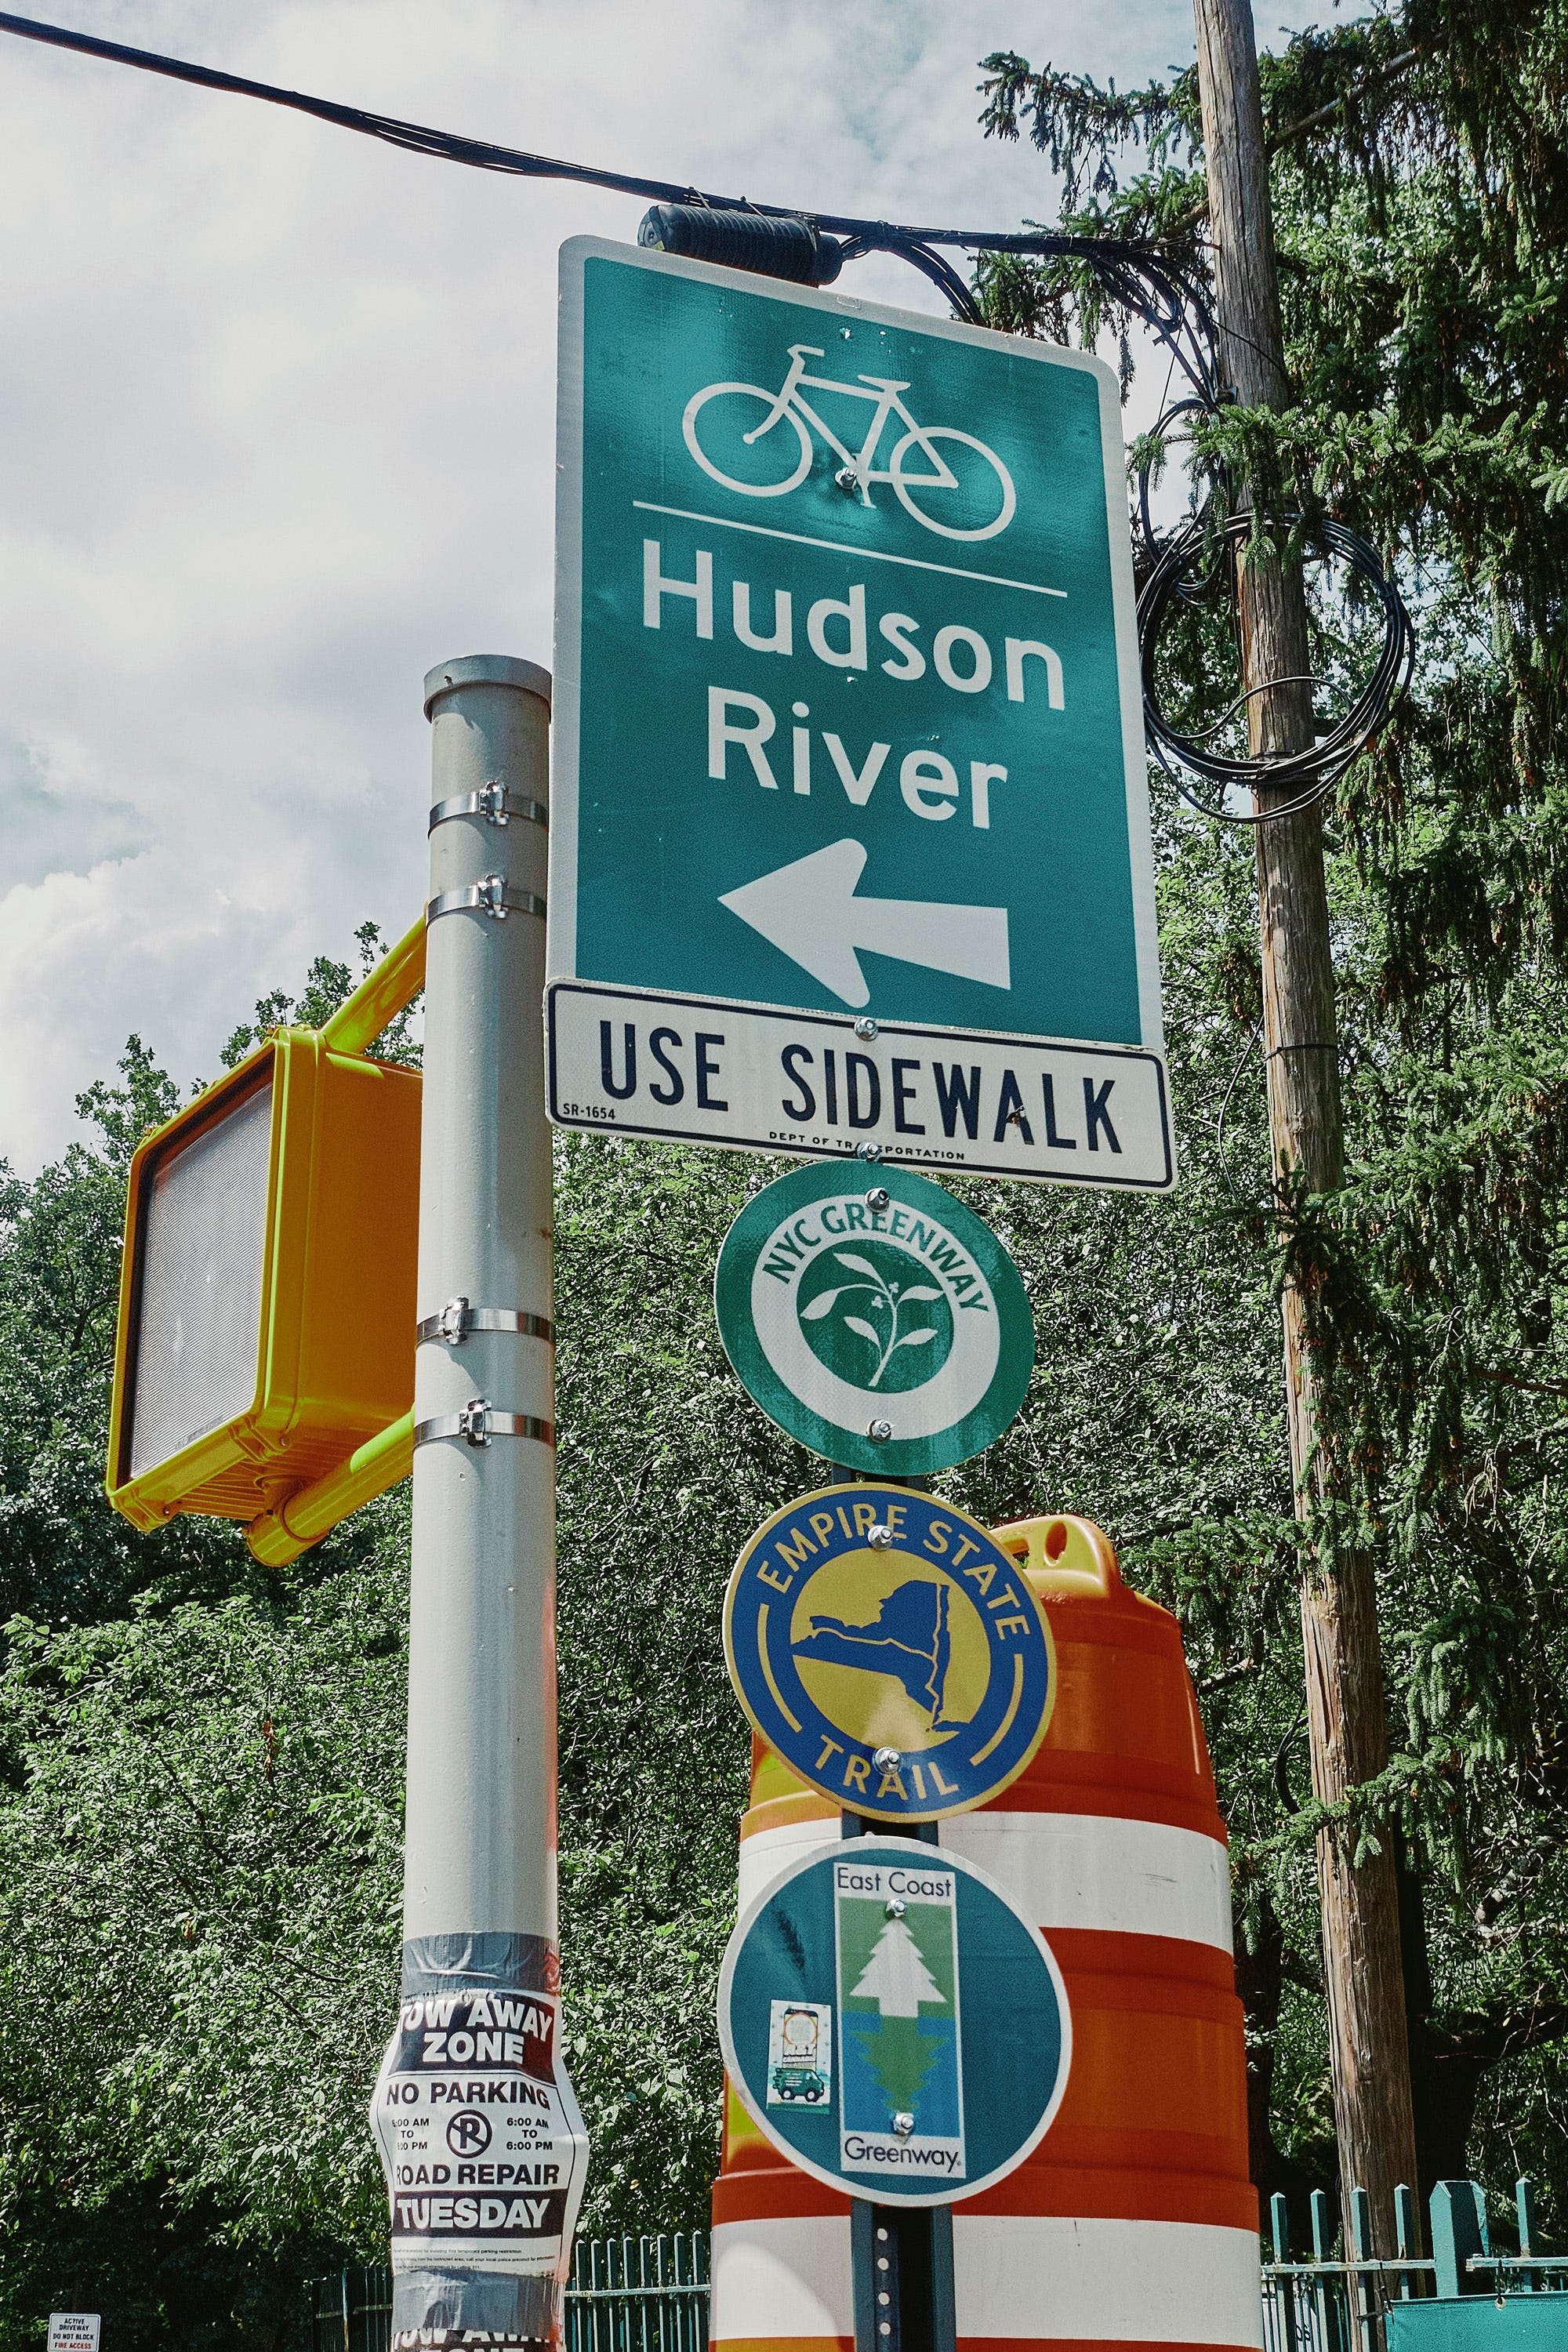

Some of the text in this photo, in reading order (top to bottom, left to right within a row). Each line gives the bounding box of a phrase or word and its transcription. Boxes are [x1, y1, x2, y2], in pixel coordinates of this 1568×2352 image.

[642, 539, 1065, 711] Hudson
[707, 685, 1009, 829] River
[600, 1020, 1123, 1154] USE SIDEWALK
[563, 1103, 615, 1120] SR-1654
[769, 1131, 965, 1160] DEPT OF TRSPORTATION
[762, 1203, 989, 1312] NYC GREENWAY
[757, 1503, 1030, 1641] EMPIRE STATE
[815, 1734, 960, 1801] TRAIL
[837, 1867, 952, 1896] East Coast
[401, 1998, 553, 2042] TOW AWAY
[423, 2031, 524, 2064] ZONE
[387, 2081, 550, 2111] NO PARKING
[506, 2118, 549, 2129] 6:00 AM
[521, 2129, 538, 2138] TO
[506, 2141, 553, 2150] 6:00 PM
[396, 2164, 560, 2186] ROAD REPAIR
[397, 2198, 550, 2229] TUESDAY
